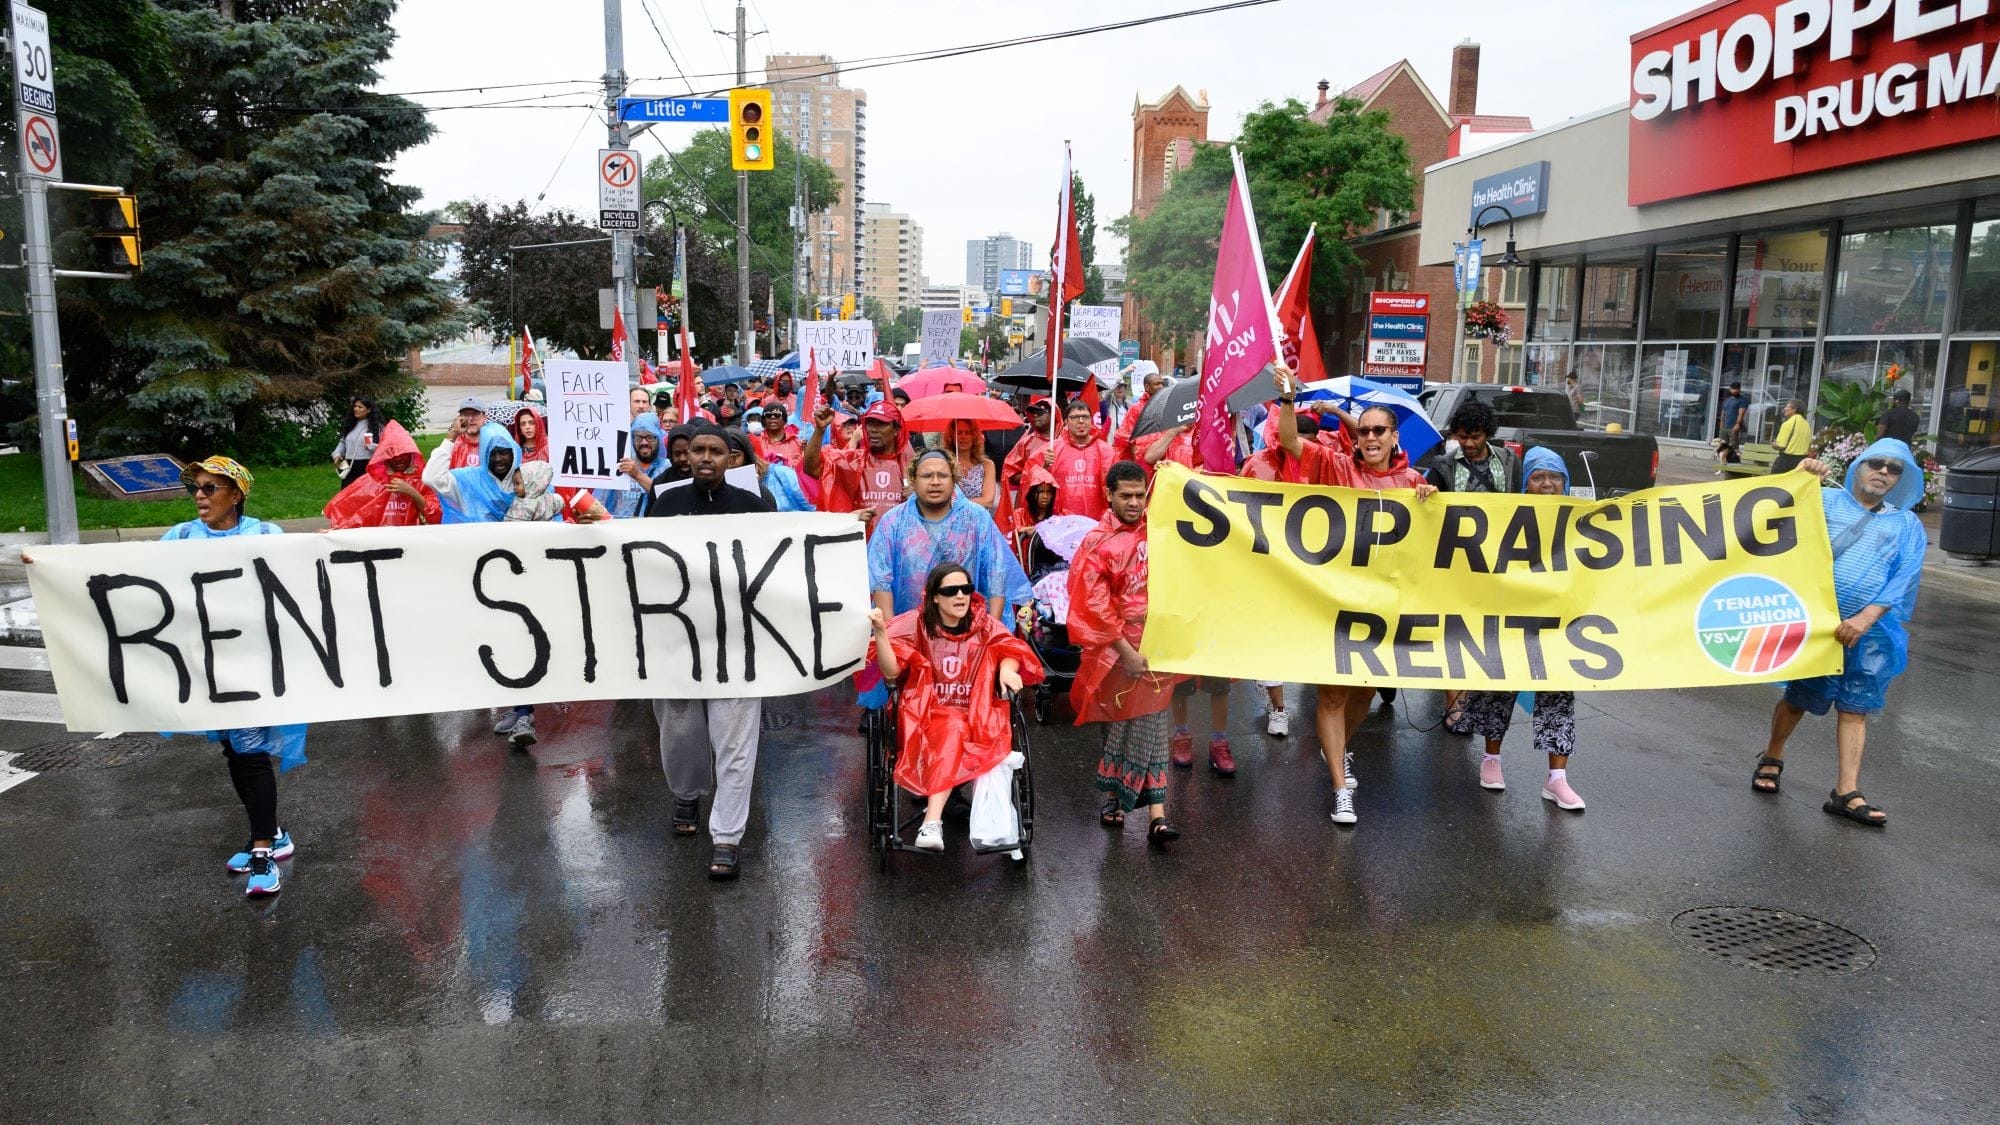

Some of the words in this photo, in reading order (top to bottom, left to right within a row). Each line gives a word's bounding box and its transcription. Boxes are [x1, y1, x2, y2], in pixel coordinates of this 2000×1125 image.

[15, 12, 45, 33] MAXIMUM
[23, 40, 47, 81] 30
[1631, 0, 1990, 121] SHOPPE
[22, 86, 53, 109] BEGINS
[1774, 62, 1918, 144] DRUG
[645, 100, 686, 117] Little
[691, 101, 702, 110] Av
[1473, 190, 1487, 207] the
[1486, 182, 1513, 204] Health
[1513, 175, 1537, 197] Clinic
[602, 219, 637, 228] EXCEPTED
[603, 211, 635, 220] BICYCLES
[1779, 258, 1819, 273] Your
[1688, 277, 1723, 296] Hearin
[931, 313, 958, 326] FAIR
[1073, 319, 1083, 328] WE
[1084, 319, 1107, 328] DON'T
[1384, 322, 1406, 330] Health
[805, 327, 837, 345] FAIR
[841, 327, 872, 346] RENT
[927, 327, 958, 337] RENT
[932, 338, 951, 348] FOR
[1384, 341, 1408, 349] TRAVEL
[814, 348, 837, 367] FOR
[841, 348, 867, 367] ALL!
[1368, 365, 1409, 374] PARKING
[561, 371, 608, 393] FAIR
[563, 400, 615, 423] RENT
[576, 426, 604, 441] FOR
[1176, 478, 1412, 567] STOP
[1434, 486, 1798, 573] RAISING
[1713, 593, 1790, 611] TENANT
[86, 547, 404, 704] RENT
[472, 531, 865, 689] STRIKE
[1739, 607, 1801, 625] UNION
[1334, 610, 1624, 681] RENTS
[935, 682, 972, 696] NIFO
